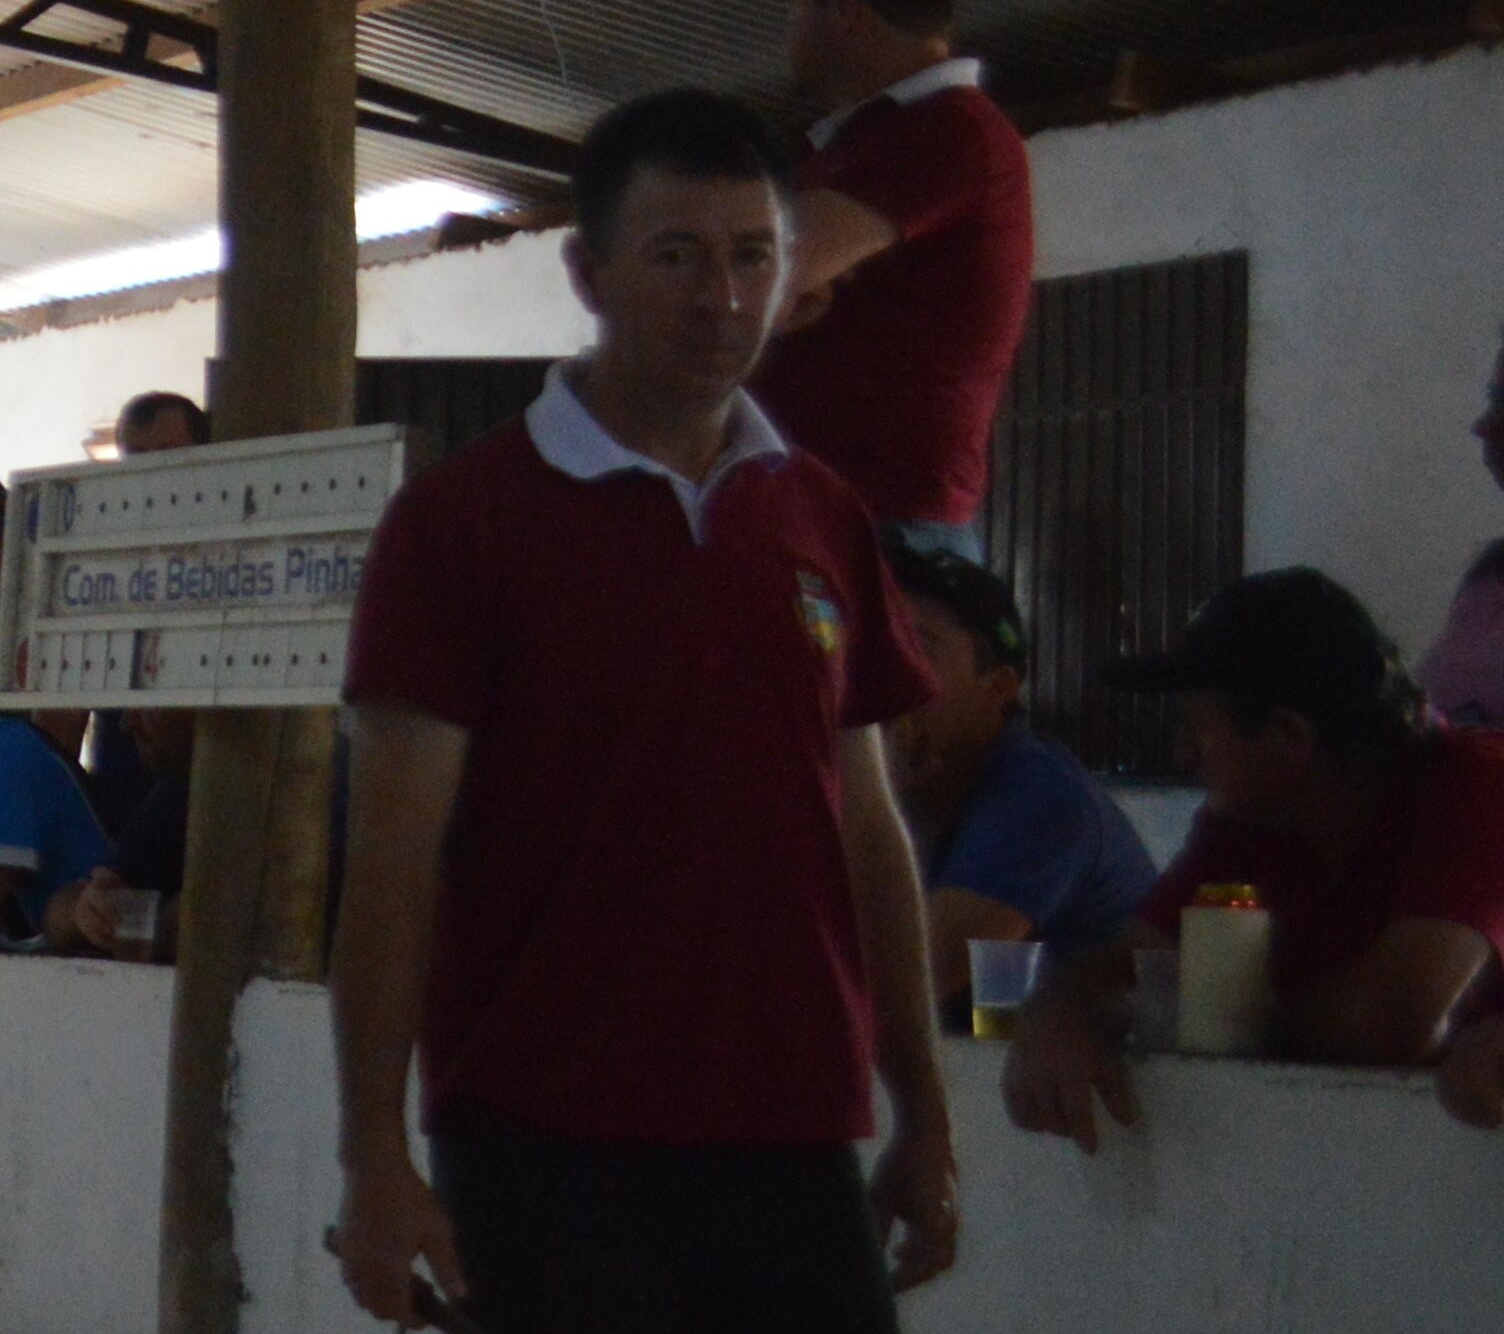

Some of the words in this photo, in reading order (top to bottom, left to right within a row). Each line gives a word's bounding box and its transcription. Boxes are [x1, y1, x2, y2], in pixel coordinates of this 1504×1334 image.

[63, 564, 122, 608] Com.
[165, 552, 275, 602] Bebidas
[284, 545, 369, 595] Pinha
